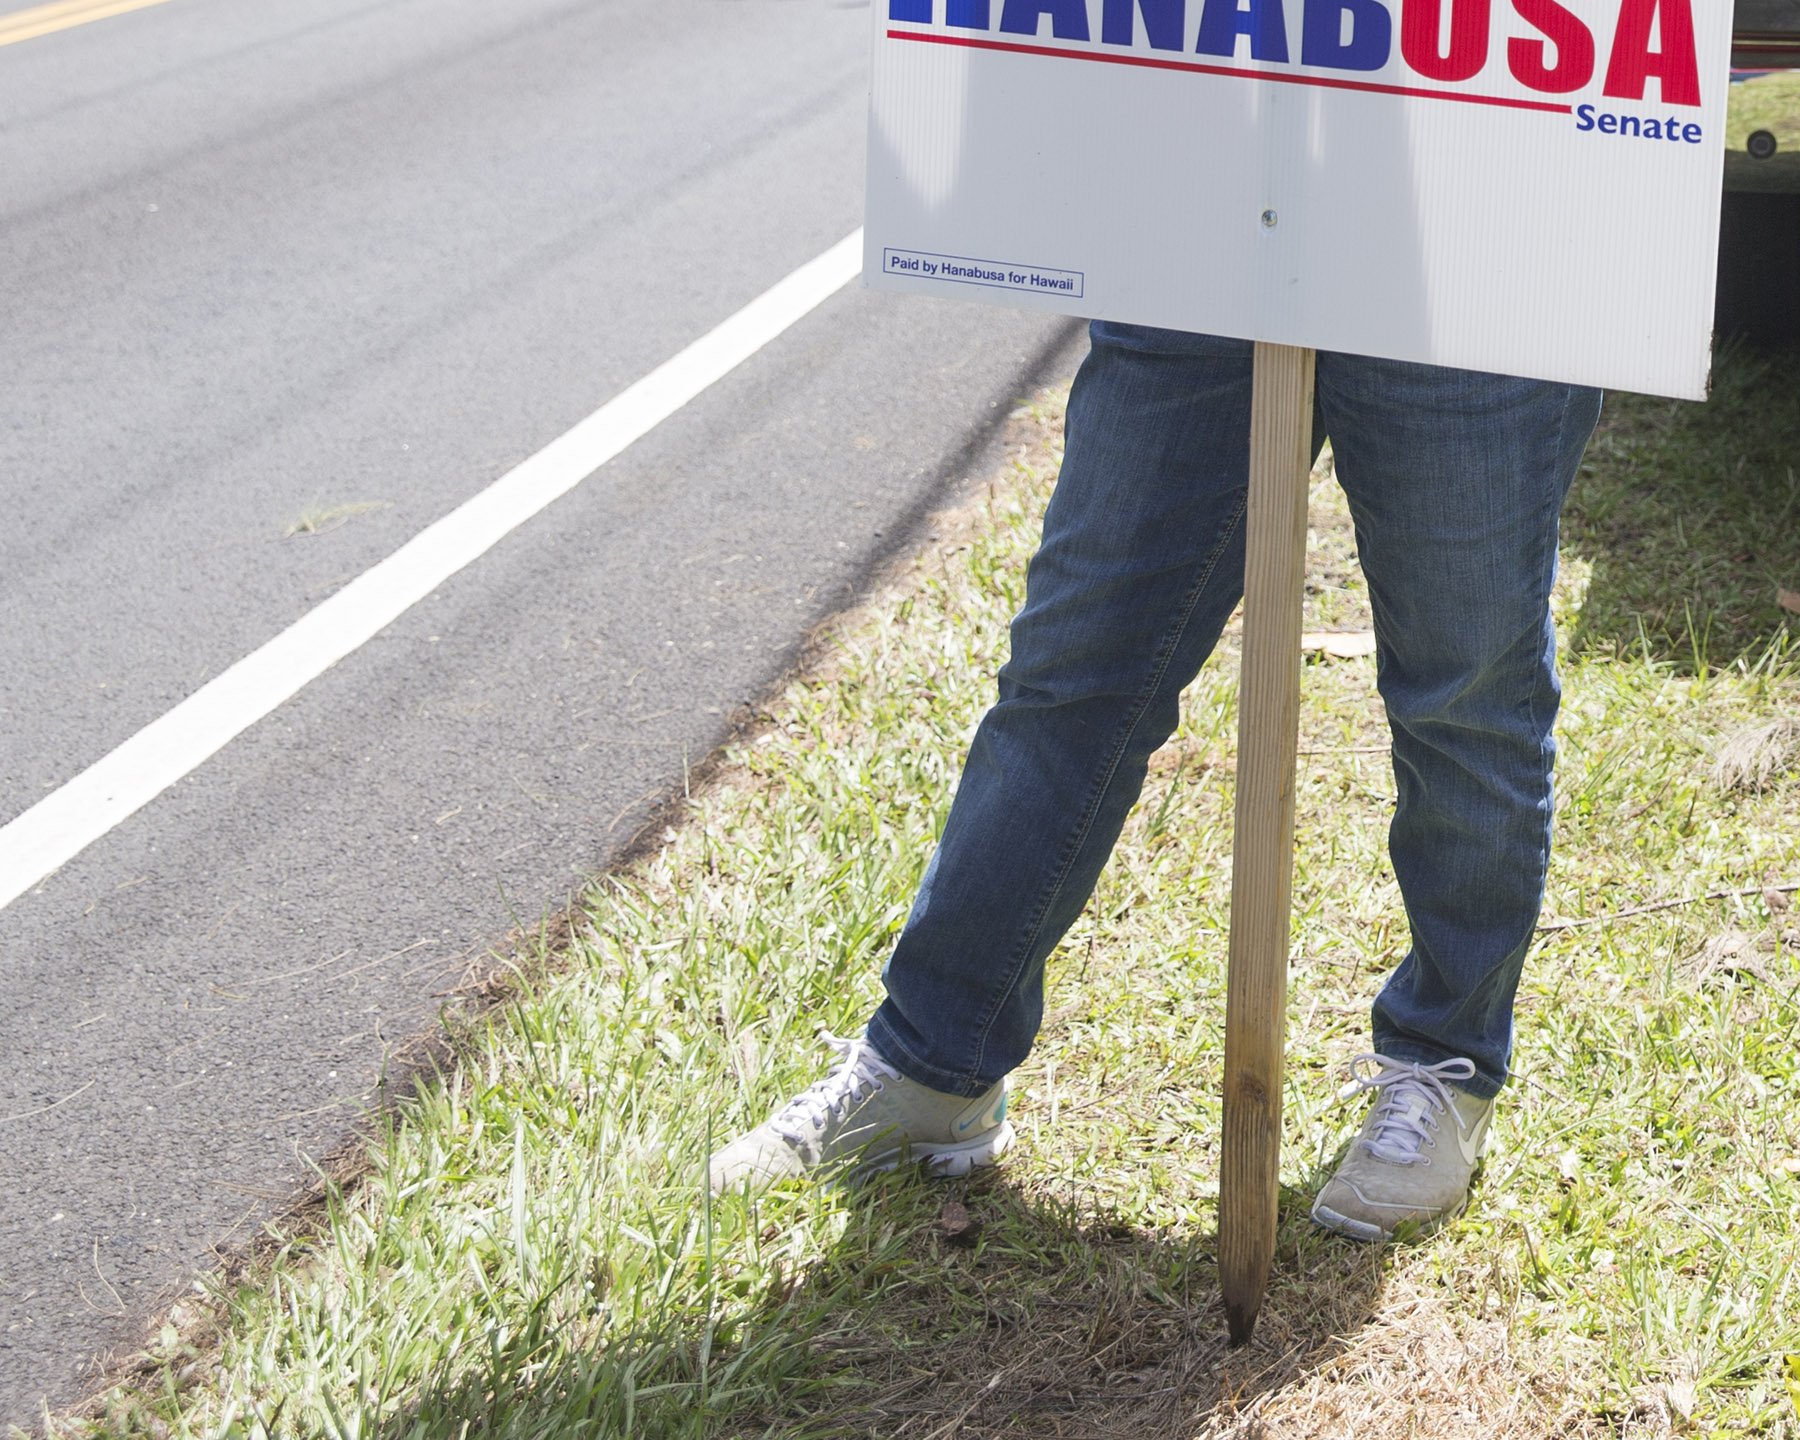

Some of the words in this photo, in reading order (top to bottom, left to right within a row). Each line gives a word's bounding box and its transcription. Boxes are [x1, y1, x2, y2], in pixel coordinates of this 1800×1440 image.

[1576, 104, 1703, 144] Senate
[891, 256, 919, 271] Paid
[922, 260, 938, 275] by
[941, 263, 1005, 282] Hanabusa
[1008, 272, 1027, 284] for
[1030, 274, 1074, 290] Hawaii
